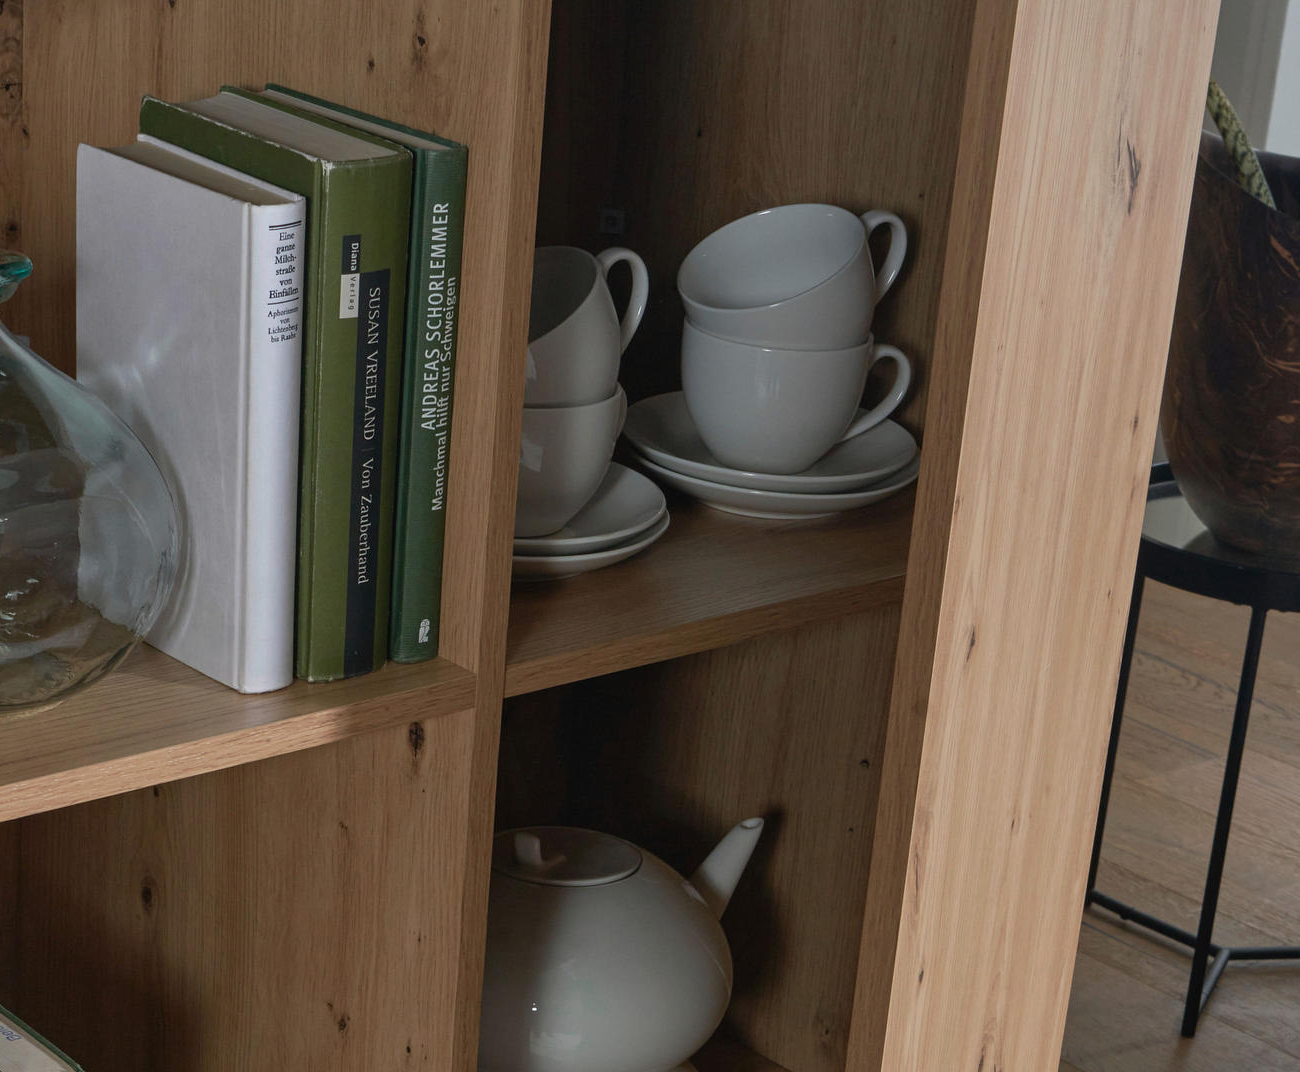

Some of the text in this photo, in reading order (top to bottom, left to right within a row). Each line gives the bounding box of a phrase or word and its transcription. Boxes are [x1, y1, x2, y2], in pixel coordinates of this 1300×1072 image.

[279, 231, 295, 241] Eine
[276, 243, 295, 254] ganze
[275, 255, 297, 264] Milch-
[275, 265, 296, 275] straße
[279, 278, 292, 286] von
[348, 242, 359, 311] Diana Verlag
[421, 202, 449, 430] ANDREAS SCHORLEMMER
[431, 276, 456, 511] Manchmal hilft nur Schweigen
[358, 287, 381, 585] SUSAN VREELAND Von Zauberhand
